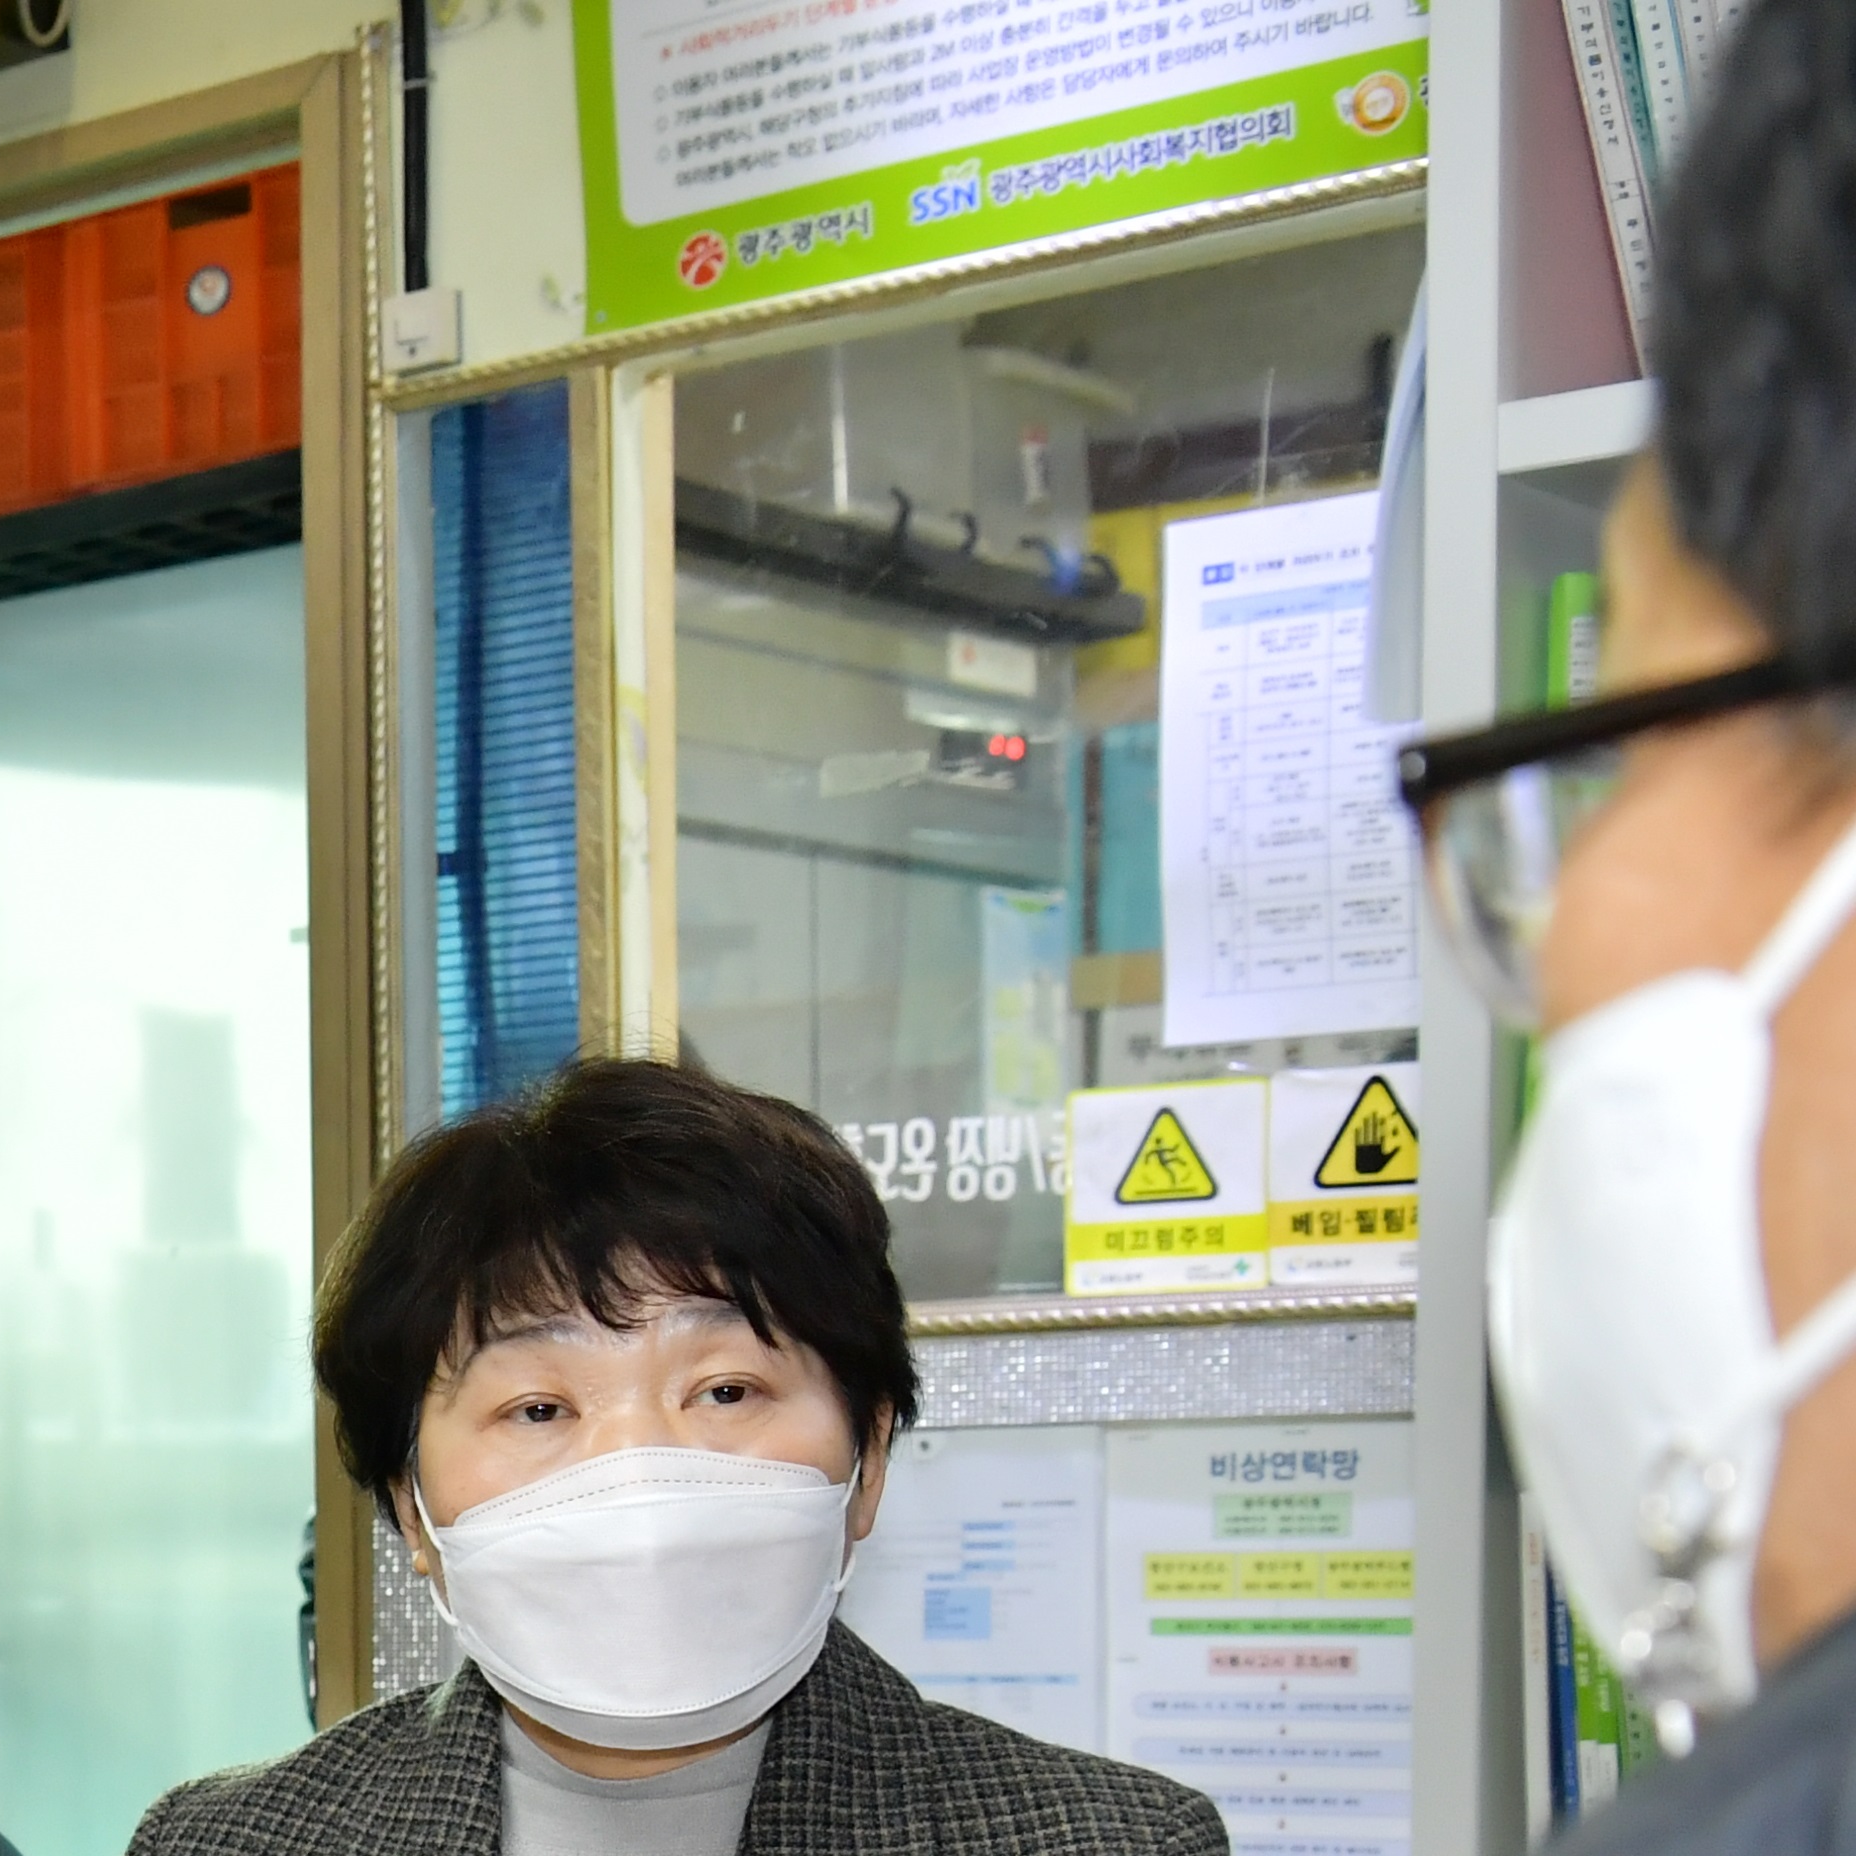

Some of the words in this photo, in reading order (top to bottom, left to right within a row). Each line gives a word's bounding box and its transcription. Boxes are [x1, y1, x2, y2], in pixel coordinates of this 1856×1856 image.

[1233, 23, 1289, 54] 주시기
[990, 104, 1293, 202] 광주광역시사회복지협의회
[913, 180, 978, 222] SSN
[738, 206, 872, 265] 광주광역시
[1104, 1214, 1225, 1252] 미끄럼주의
[1210, 1448, 1359, 1482] 비상연락망
